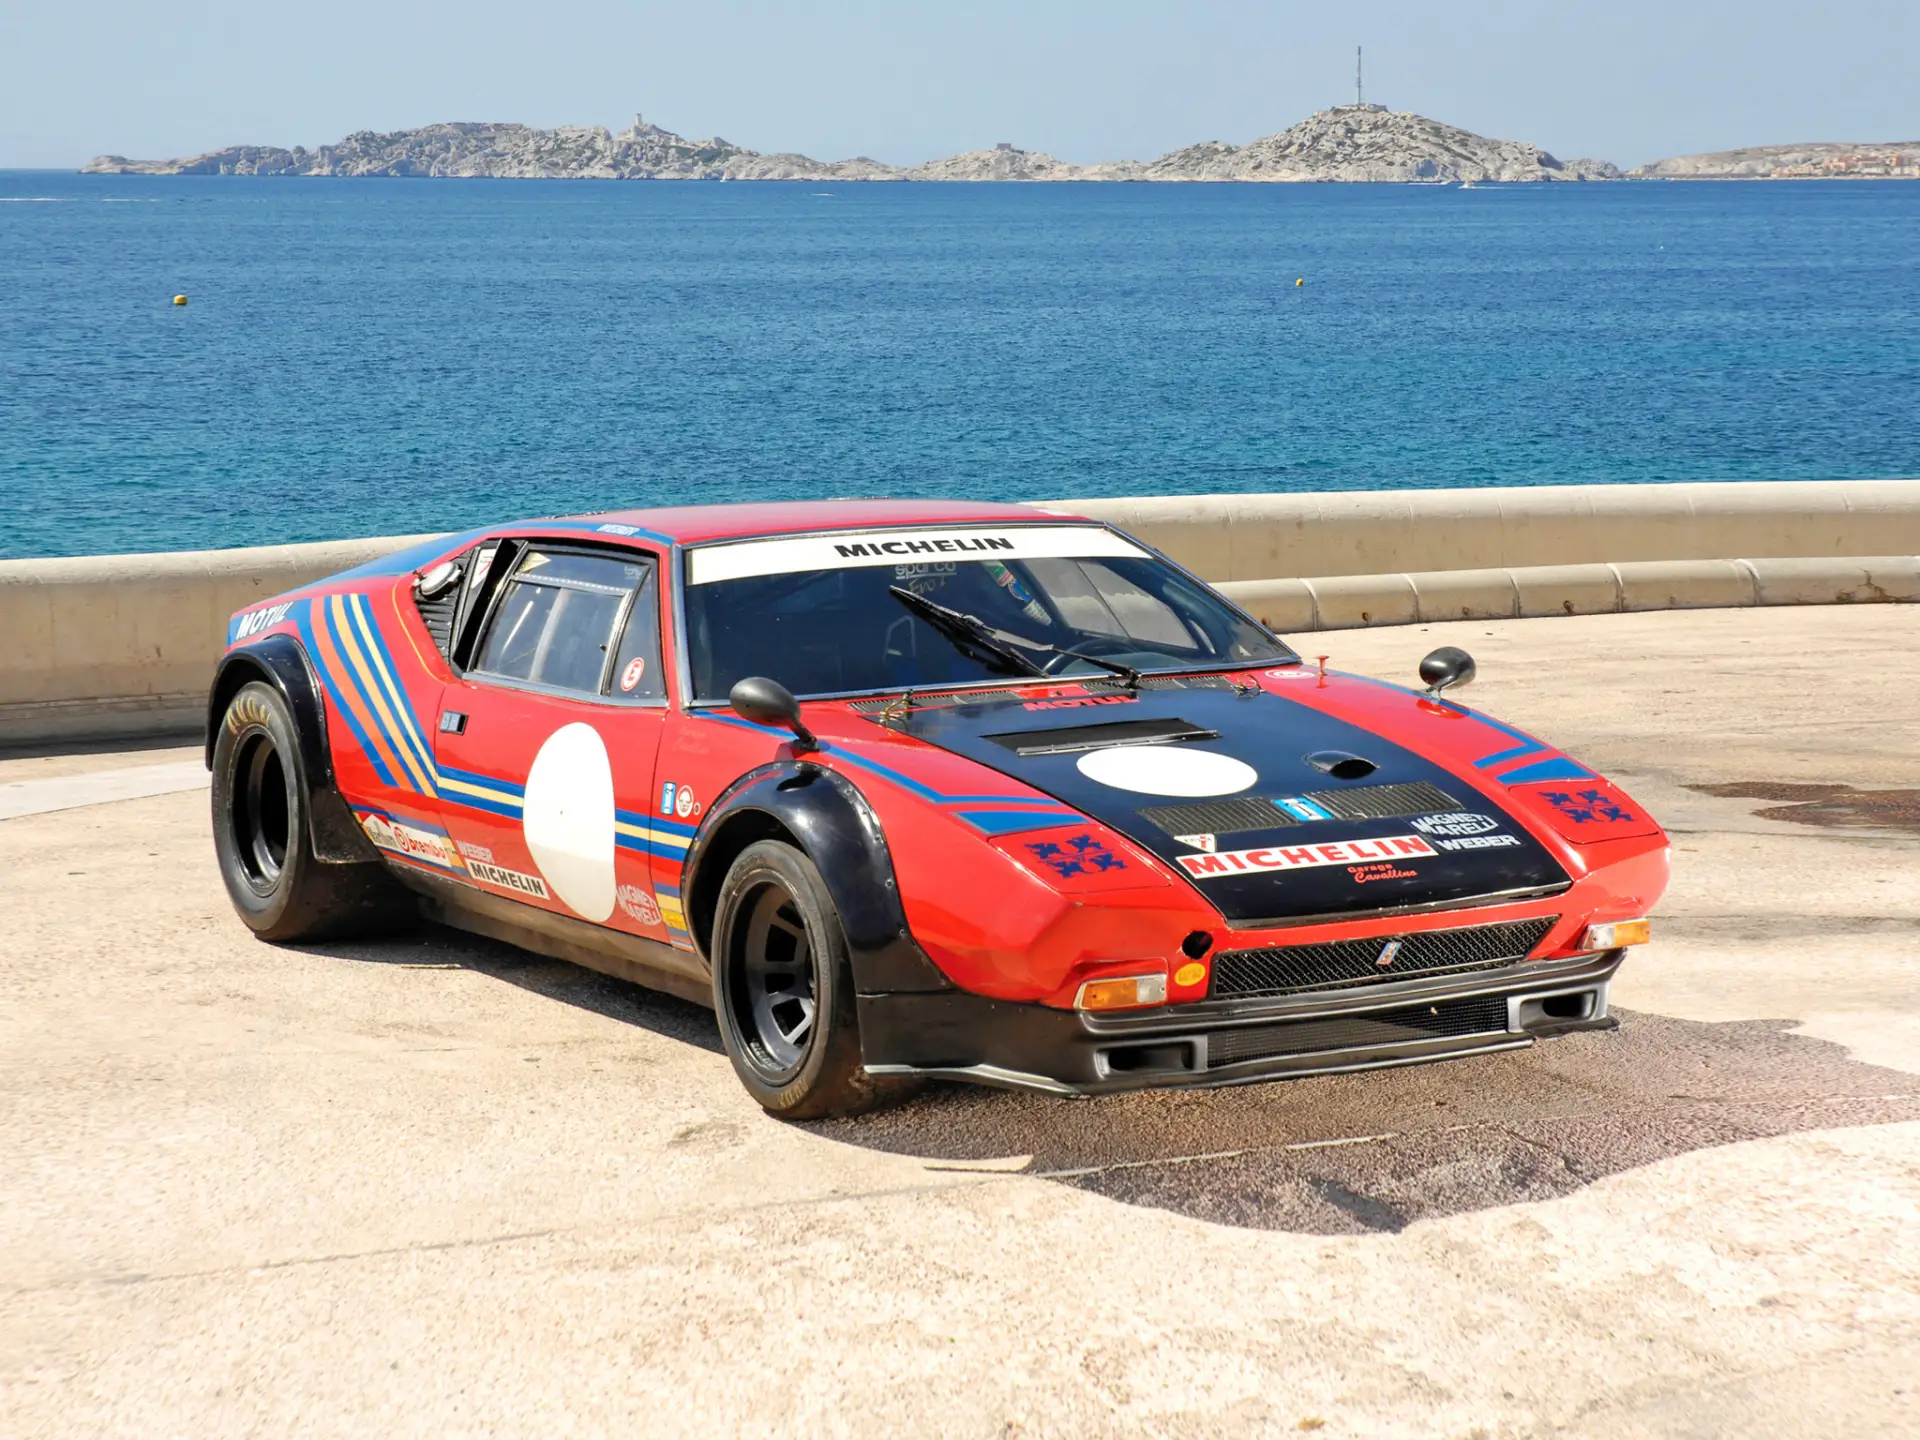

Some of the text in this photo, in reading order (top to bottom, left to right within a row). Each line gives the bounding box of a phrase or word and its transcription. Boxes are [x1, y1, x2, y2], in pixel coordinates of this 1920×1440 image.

[833, 537, 1016, 558] MICHELIN
[235, 601, 295, 640] MOTUL
[1022, 695, 1140, 712] MOTUL
[456, 840, 497, 865] WEBER
[1435, 834, 1522, 850] WEBER
[1178, 836, 1433, 876] MICHELIN
[469, 861, 546, 896] MICHELIN
[1347, 863, 1393, 873] Garage
[1354, 869, 1419, 884] Cavallino
